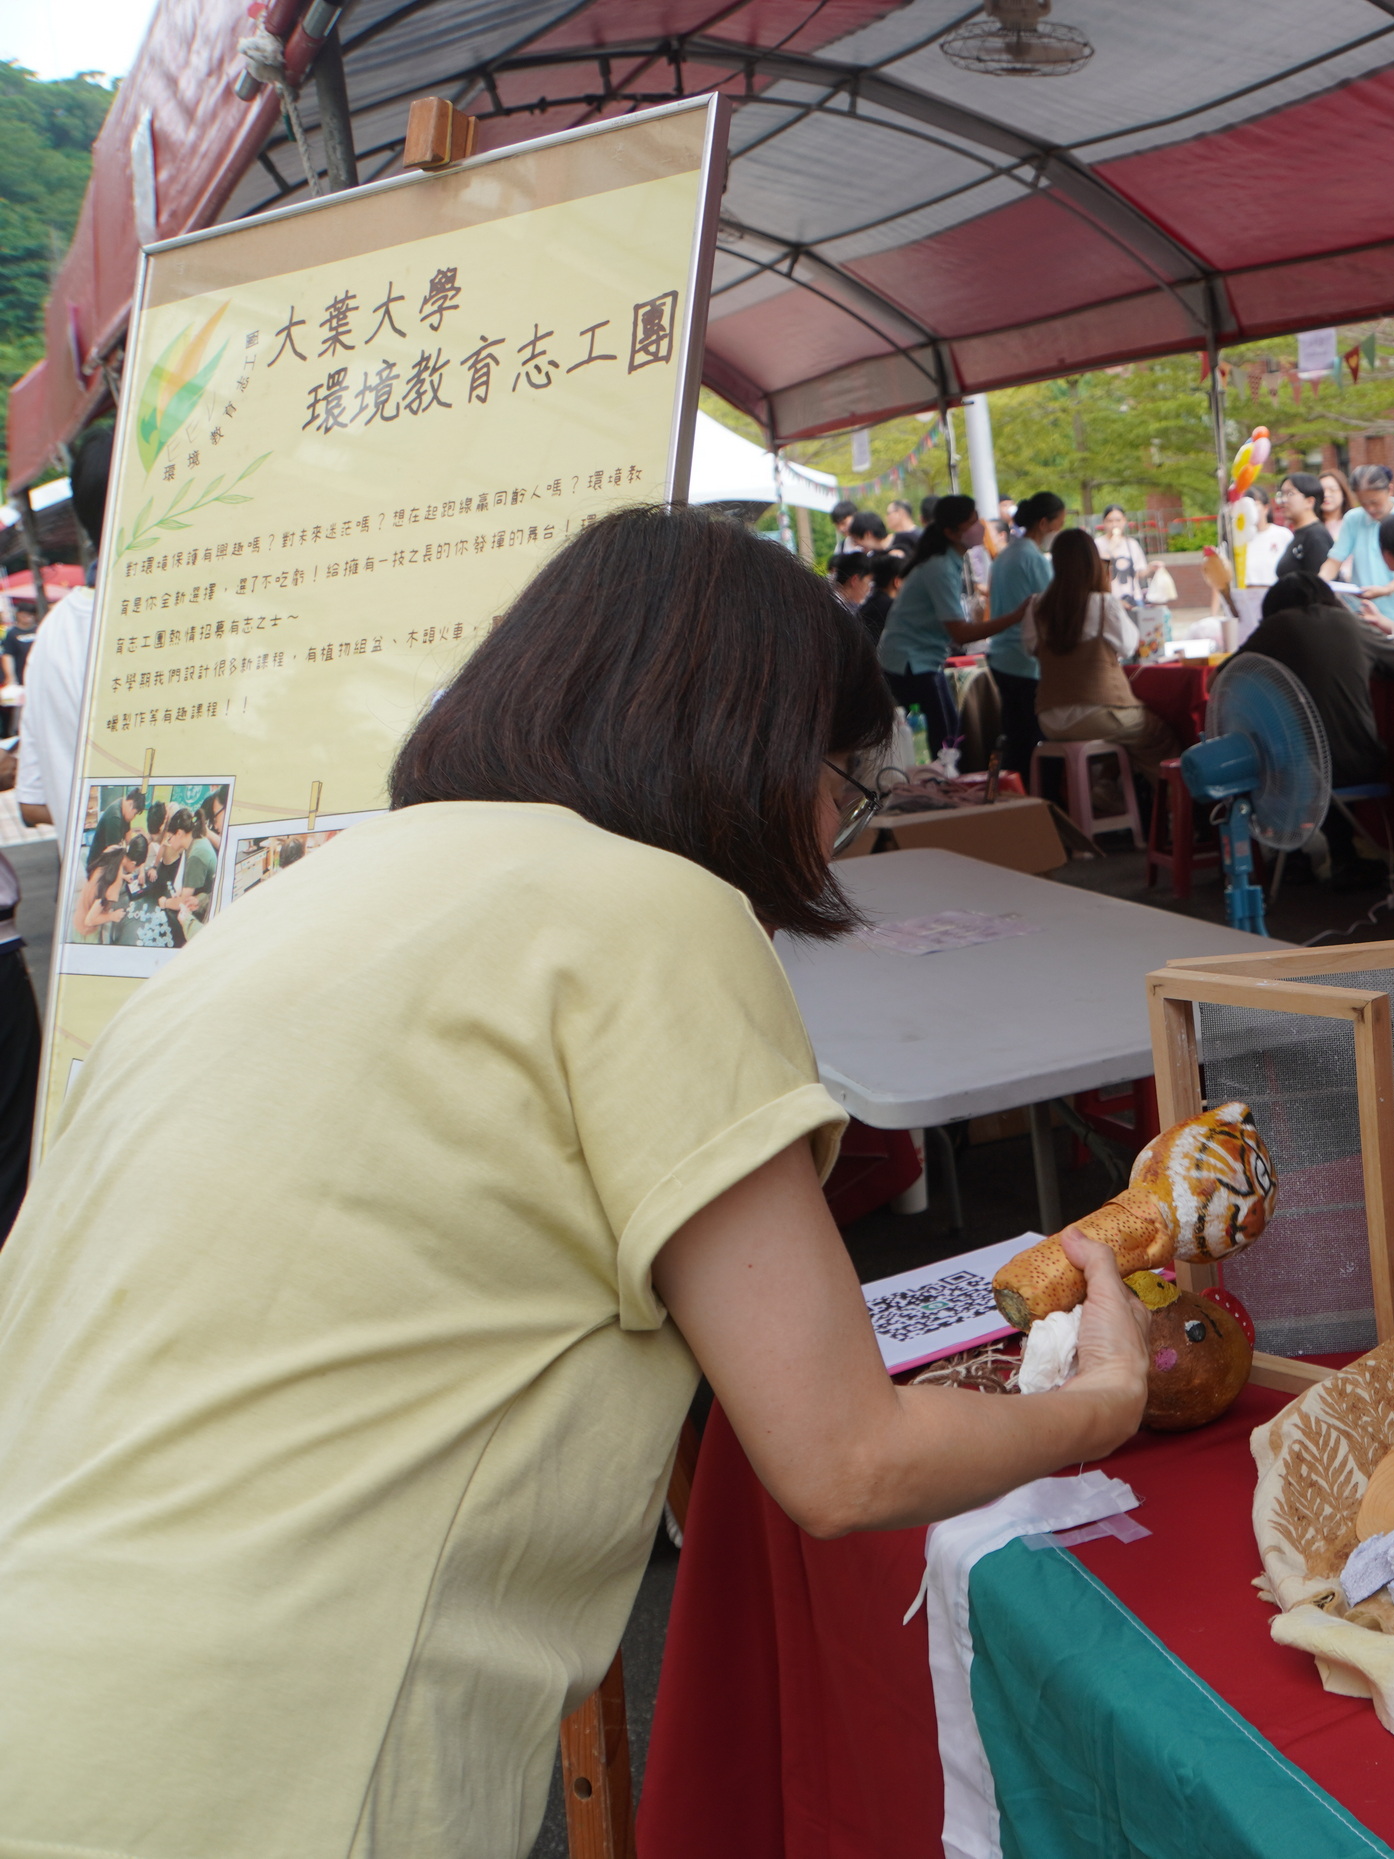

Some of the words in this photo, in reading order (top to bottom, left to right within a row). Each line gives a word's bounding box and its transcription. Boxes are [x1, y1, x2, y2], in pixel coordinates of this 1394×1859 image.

[267, 266, 463, 369] 大葉大學
[301, 289, 681, 436] 環境教育志工團
[111, 615, 503, 694] 本學期我們設計很多新課程，有植物組盆、木頭火車，
